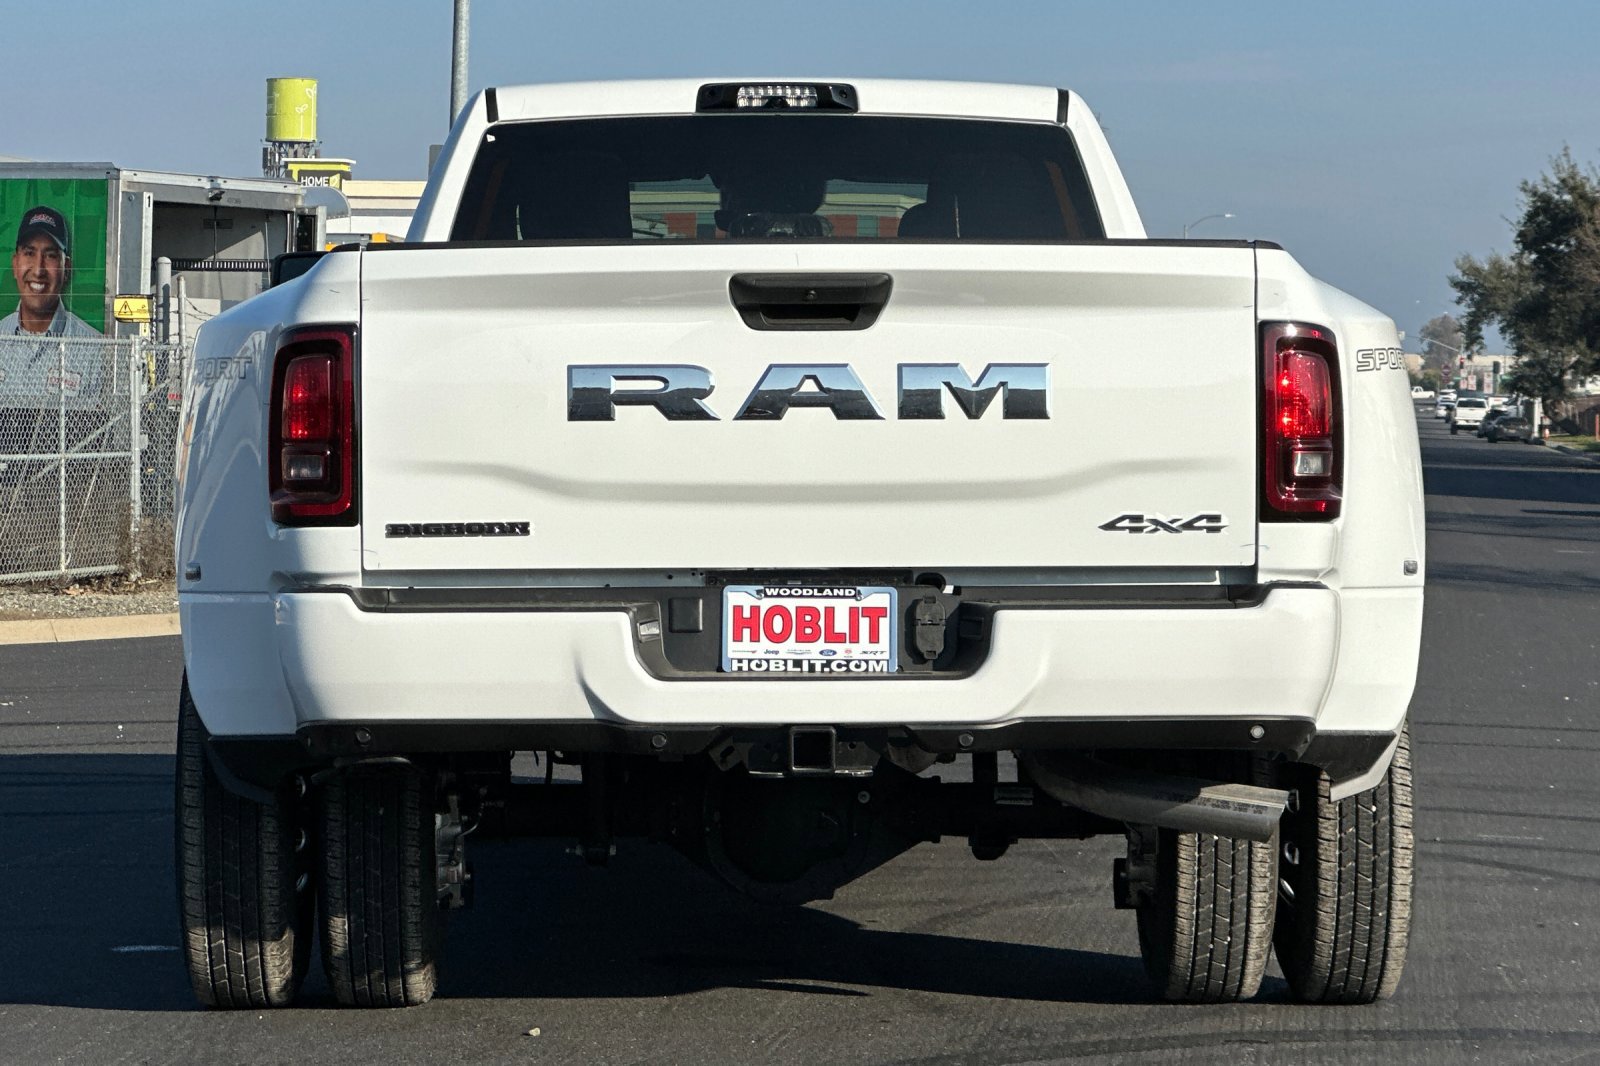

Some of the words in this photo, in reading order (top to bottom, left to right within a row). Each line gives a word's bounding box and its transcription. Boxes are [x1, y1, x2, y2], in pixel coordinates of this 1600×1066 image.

[301, 176, 329, 187] HOME
[566, 362, 1051, 421] RAM
[765, 588, 856, 597] WOODLAND
[732, 604, 888, 644] HOBLIT
[731, 659, 888, 672] HOBLIT.COM
